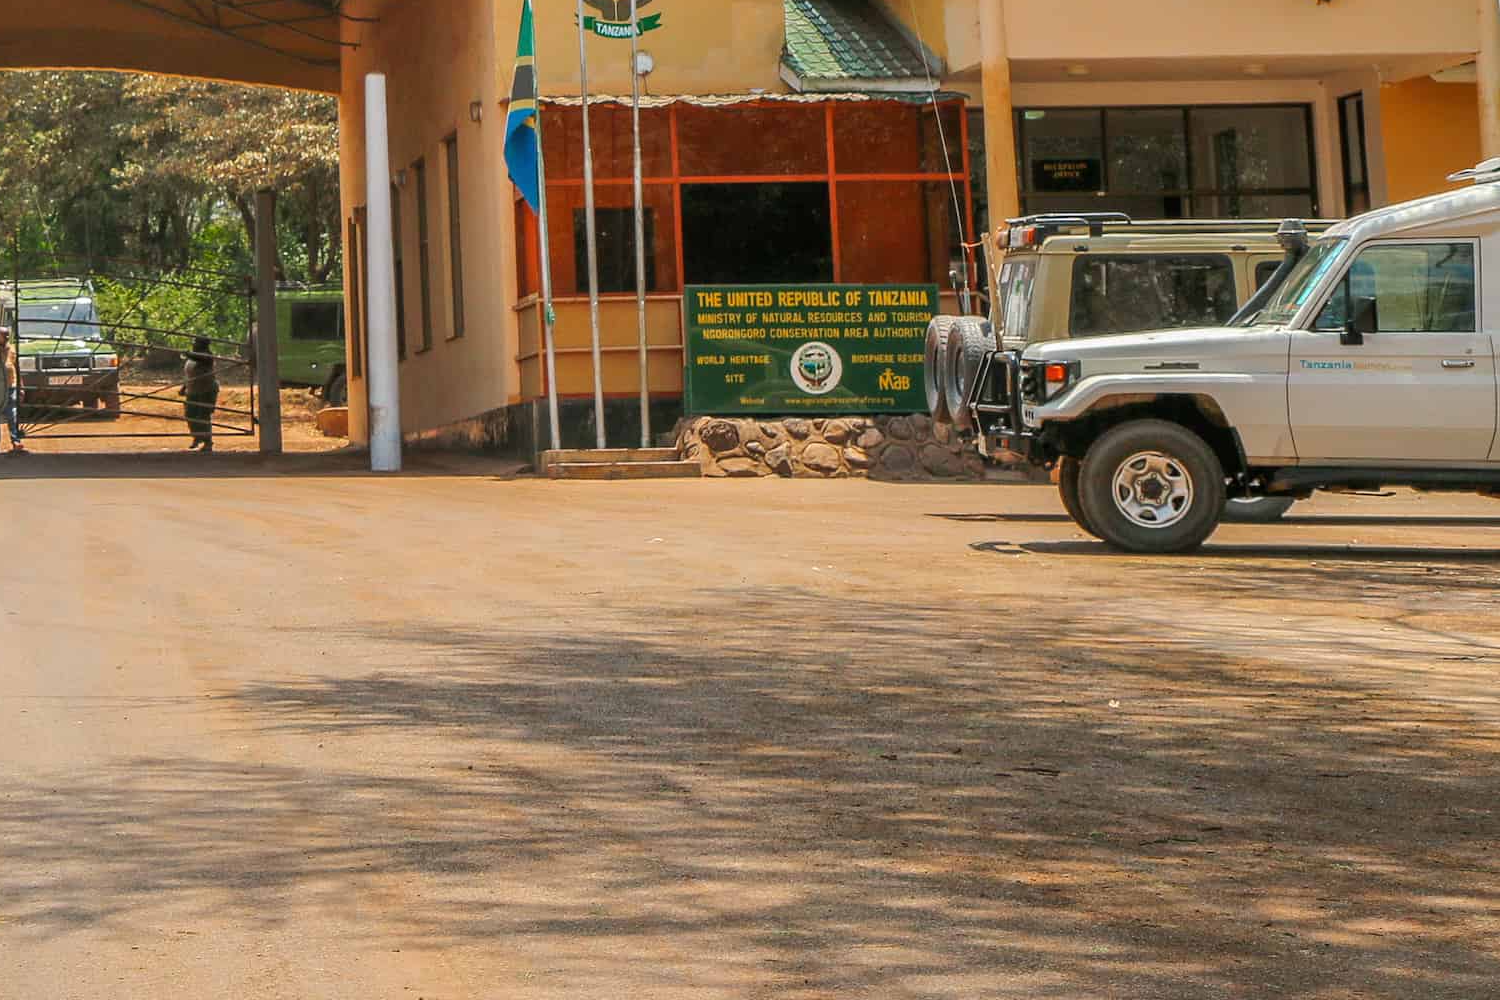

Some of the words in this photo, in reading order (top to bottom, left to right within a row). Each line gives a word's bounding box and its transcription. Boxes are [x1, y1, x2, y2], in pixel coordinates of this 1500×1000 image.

[596, 22, 640, 37] TANZANA
[697, 292, 722, 307] THE
[727, 292, 773, 307] UNITED
[778, 291, 840, 307] REPUBLIC
[846, 291, 861, 306] OF
[868, 290, 928, 306] TANZANIA
[697, 313, 741, 324] MINISTRY
[746, 313, 758, 324] OF
[762, 312, 805, 324] NATURAL
[808, 312, 863, 323] RESOURCES
[868, 312, 886, 323] AND
[892, 312, 932, 323] TOURISM
[703, 328, 766, 339] NGORONGORO
[770, 328, 840, 338] CONSERVATION
[844, 328, 869, 338] AREA
[874, 328, 925, 337] AUTHORITY
[1300, 359, 1352, 369] Tanzania
[724, 373, 746, 384] SITE
